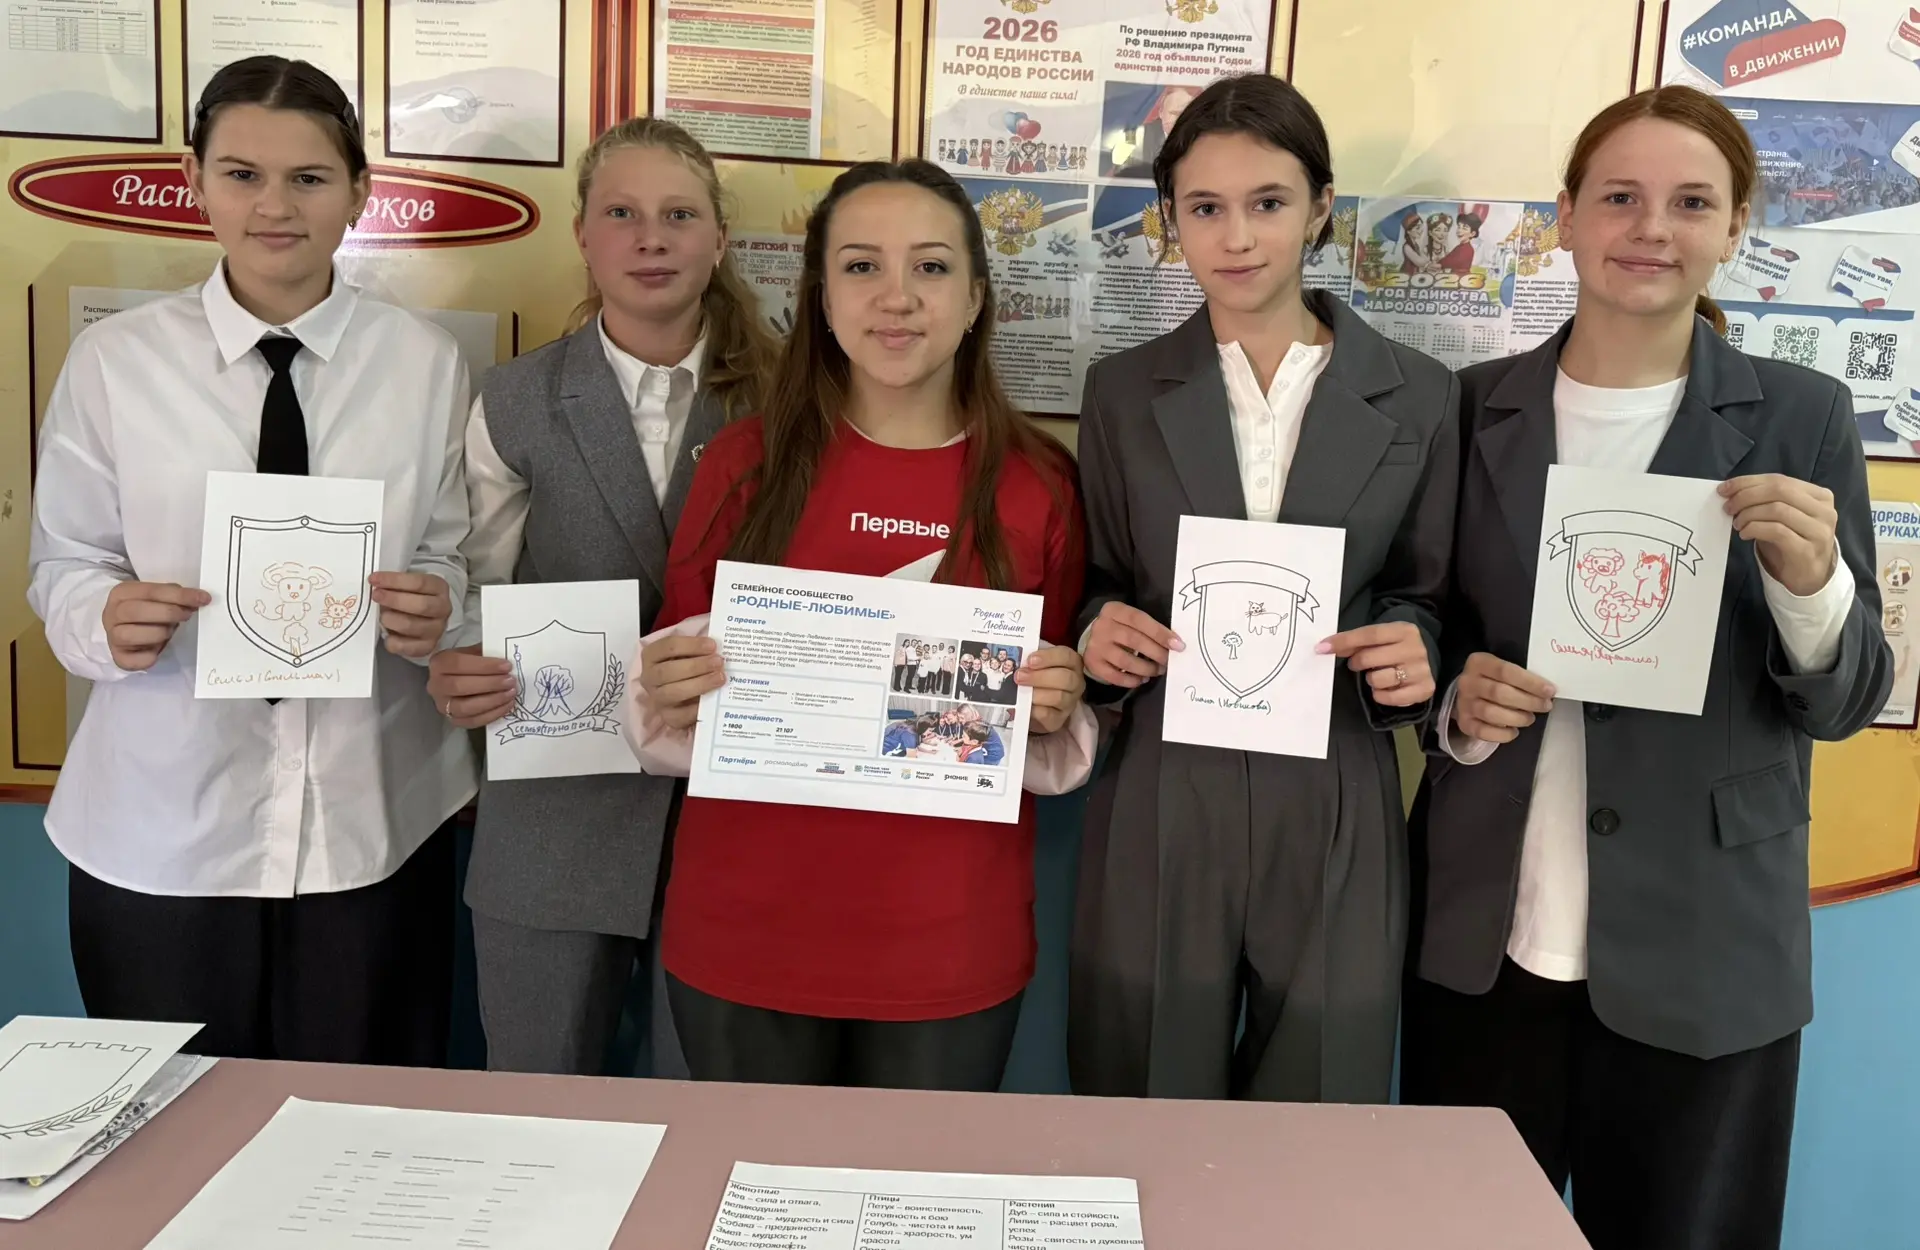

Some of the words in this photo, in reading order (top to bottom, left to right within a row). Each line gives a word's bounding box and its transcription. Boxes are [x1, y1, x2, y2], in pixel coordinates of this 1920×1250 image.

[983, 16, 1058, 43] 2026
[1119, 25, 1133, 35] По
[1135, 27, 1187, 40] решению
[1190, 30, 1253, 43] президента
[1683, 7, 1797, 49] #КОМАНДА
[1125, 37, 1140, 48] РФ
[1143, 38, 1205, 53] Владимира
[1207, 43, 1245, 55] Путина
[956, 44, 989, 60] ГОД
[994, 48, 1083, 64] ЕДИНСТВА
[1116, 49, 1141, 59] 2026
[1144, 53, 1161, 62] год
[1164, 52, 1217, 65] объявлен
[1219, 56, 1252, 67] Годом
[942, 62, 1022, 79] НАРОДОВ
[1027, 67, 1094, 82] РОССИИ
[1114, 61, 1163, 73] единства
[1166, 64, 1215, 76] народов
[958, 84, 967, 95] В
[968, 85, 1017, 98] единстве
[1020, 89, 1048, 100] наша
[1050, 89, 1079, 101] сила!
[112, 174, 197, 209] Расп
[362, 196, 436, 229] оков
[1746, 252, 1791, 274] движении
[1839, 258, 1876, 279] Движение
[755, 275, 791, 286] ПРОСТО
[1384, 272, 1486, 289] 2026
[1375, 286, 1409, 300] ГОД
[1410, 288, 1489, 302] ЕДИНСТВА
[84, 304, 123, 315] Расписани
[1363, 299, 1437, 315] НАРОДОВ
[1438, 302, 1501, 317] РОССИИ
[1871, 510, 1920, 525] ДОРОВЬ
[850, 512, 951, 539] Первые
[1879, 525, 1920, 539] РУКАХ
[731, 583, 785, 595] СЕМЕЙНОЕ
[785, 588, 854, 602] СООБЩЕСТВО
[729, 595, 896, 620] «РОДНЫЕ-ЛЮБИМЫЕ»
[973, 607, 1005, 621] Родные
[734, 617, 766, 626] проекте
[983, 620, 1026, 633] Любимые
[729, 676, 770, 686] Участники
[724, 711, 784, 723] Вовлечённость
[717, 755, 757, 766] Партнёры
[727, 1190, 745, 1201] Лев
[730, 1182, 780, 1196] Животные
[869, 1194, 900, 1203] Птицы
[1008, 1200, 1055, 1209] Растения
[724, 1200, 788, 1214] великодушие
[867, 1202, 895, 1211] Петух
[721, 1208, 765, 1221] Медведь
[775, 1216, 821, 1224] мудрость
[865, 1212, 919, 1220] готовность
[1008, 1209, 1028, 1217] Дуб
[1070, 1211, 1120, 1220] стойкость
[718, 1217, 755, 1229] Собака
[765, 1224, 828, 1232] преданность
[864, 1219, 898, 1228] Голубь
[1049, 1219, 1088, 1227] расцвет
[715, 1225, 742, 1236] Змея
[751, 1232, 799, 1240] мудрость
[862, 1227, 894, 1235] Сокол
[1008, 1234, 1034, 1242] Розы
[712, 1235, 807, 1250] предосторожность
[860, 1237, 901, 1245] красота
